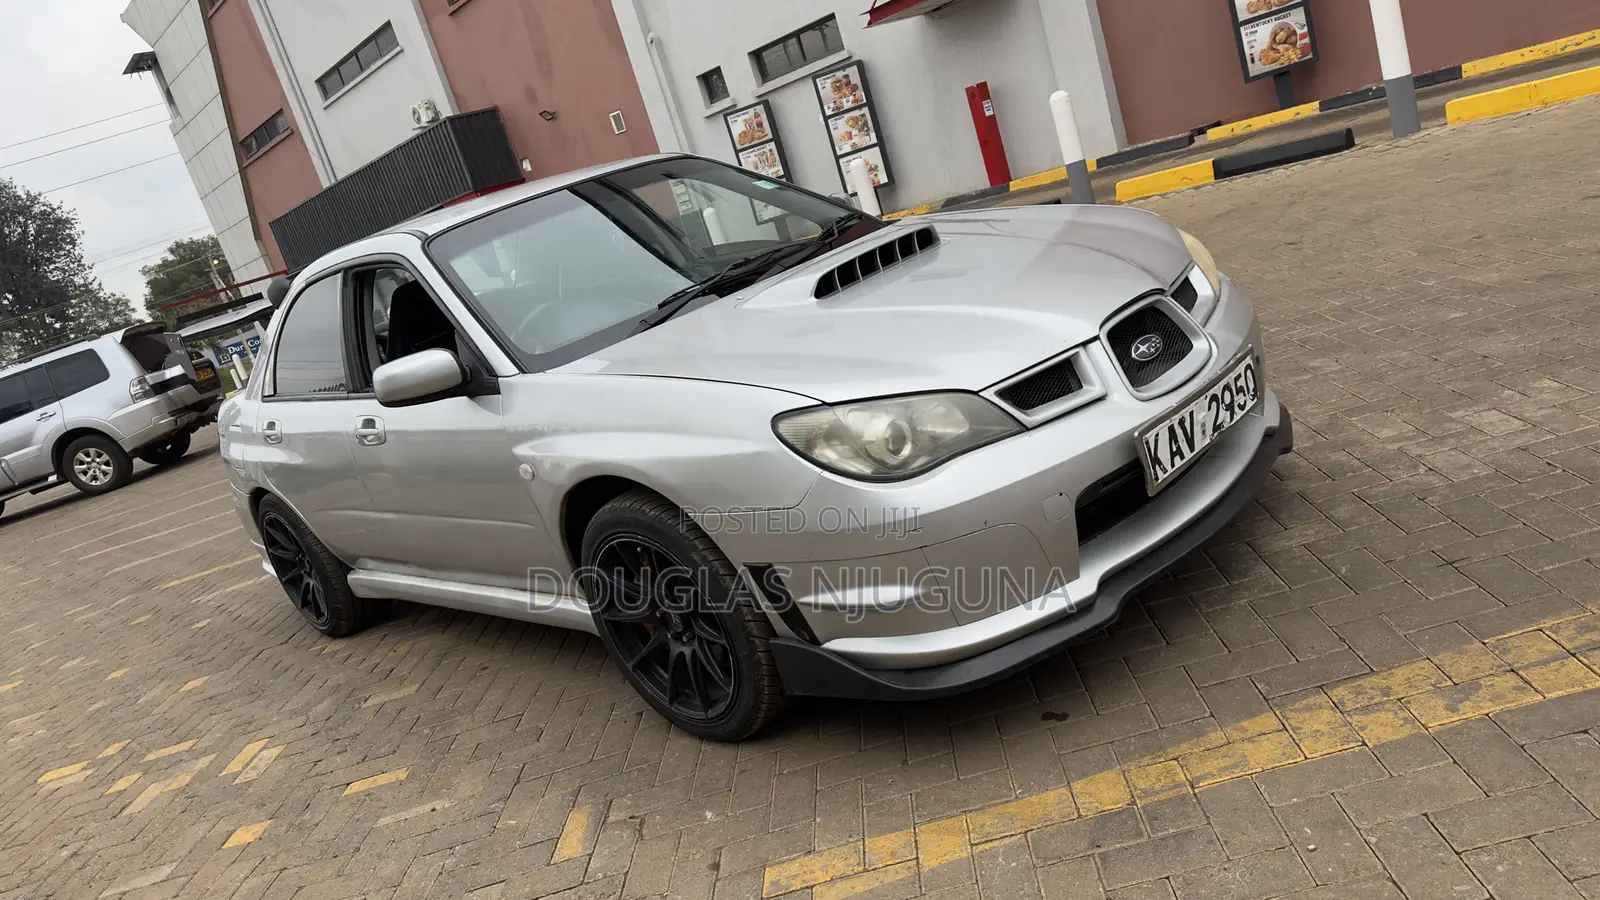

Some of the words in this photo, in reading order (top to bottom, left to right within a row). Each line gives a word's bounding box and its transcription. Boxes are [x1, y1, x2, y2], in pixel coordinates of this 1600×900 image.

[1250, 18, 1273, 30] KENTUCKY
[1274, 12, 1292, 22] BUCKET
[1145, 410, 1196, 482] KAV
